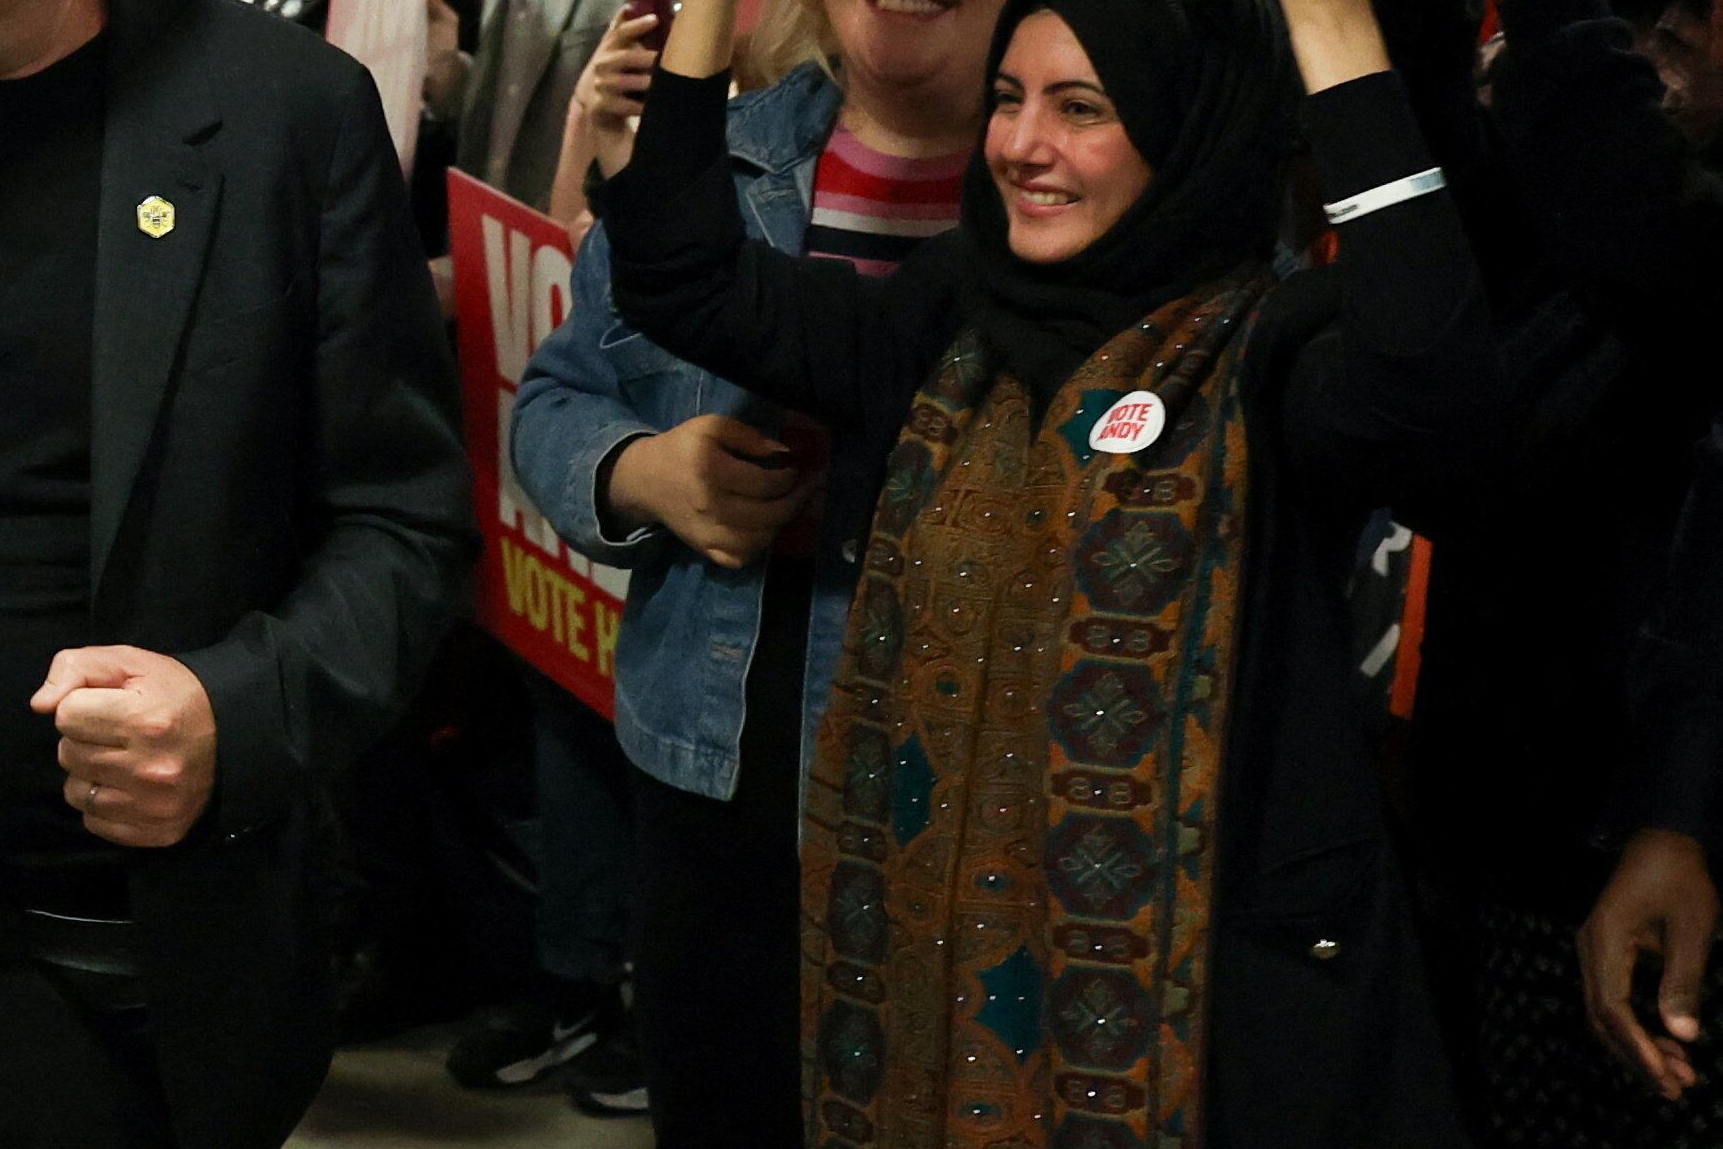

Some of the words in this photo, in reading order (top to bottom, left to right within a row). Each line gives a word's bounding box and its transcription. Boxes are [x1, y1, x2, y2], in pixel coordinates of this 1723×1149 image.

[1107, 402, 1153, 424] VOTE
[1097, 421, 1144, 441] ANDY
[500, 535, 589, 661] VOTE
